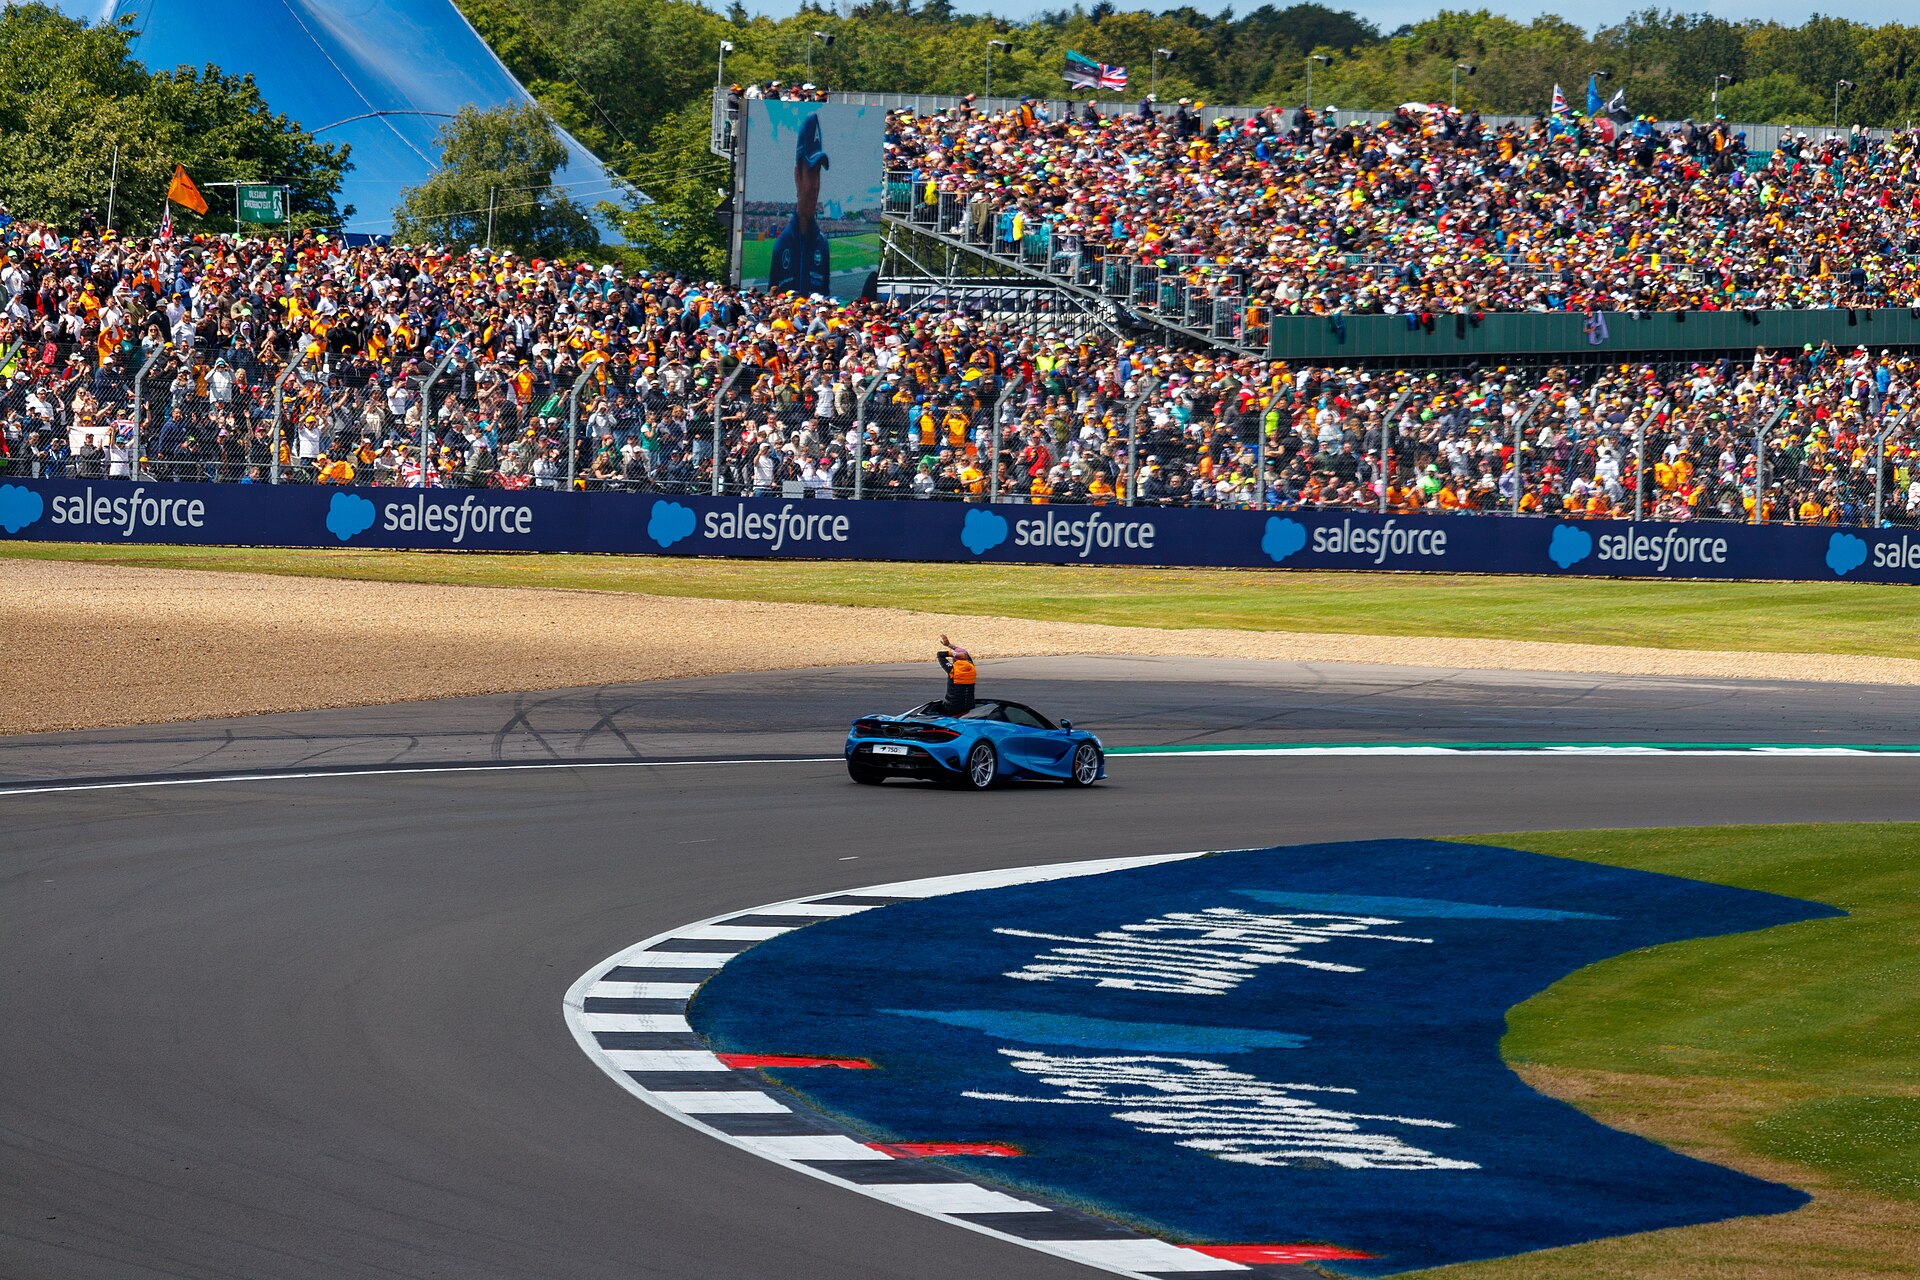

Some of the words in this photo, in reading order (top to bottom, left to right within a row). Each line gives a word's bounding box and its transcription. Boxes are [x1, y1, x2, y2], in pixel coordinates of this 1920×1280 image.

[52, 487, 205, 536] salesforce
[384, 494, 532, 543] salesforce
[704, 503, 849, 550] salesforce
[1015, 511, 1155, 557] salesforce
[1312, 519, 1447, 564] salesforce
[1598, 526, 1727, 571] salesforce
[1873, 535, 1920, 569] sale
[993, 907, 1433, 995] salesforce
[961, 1048, 1481, 1169] salesforce
